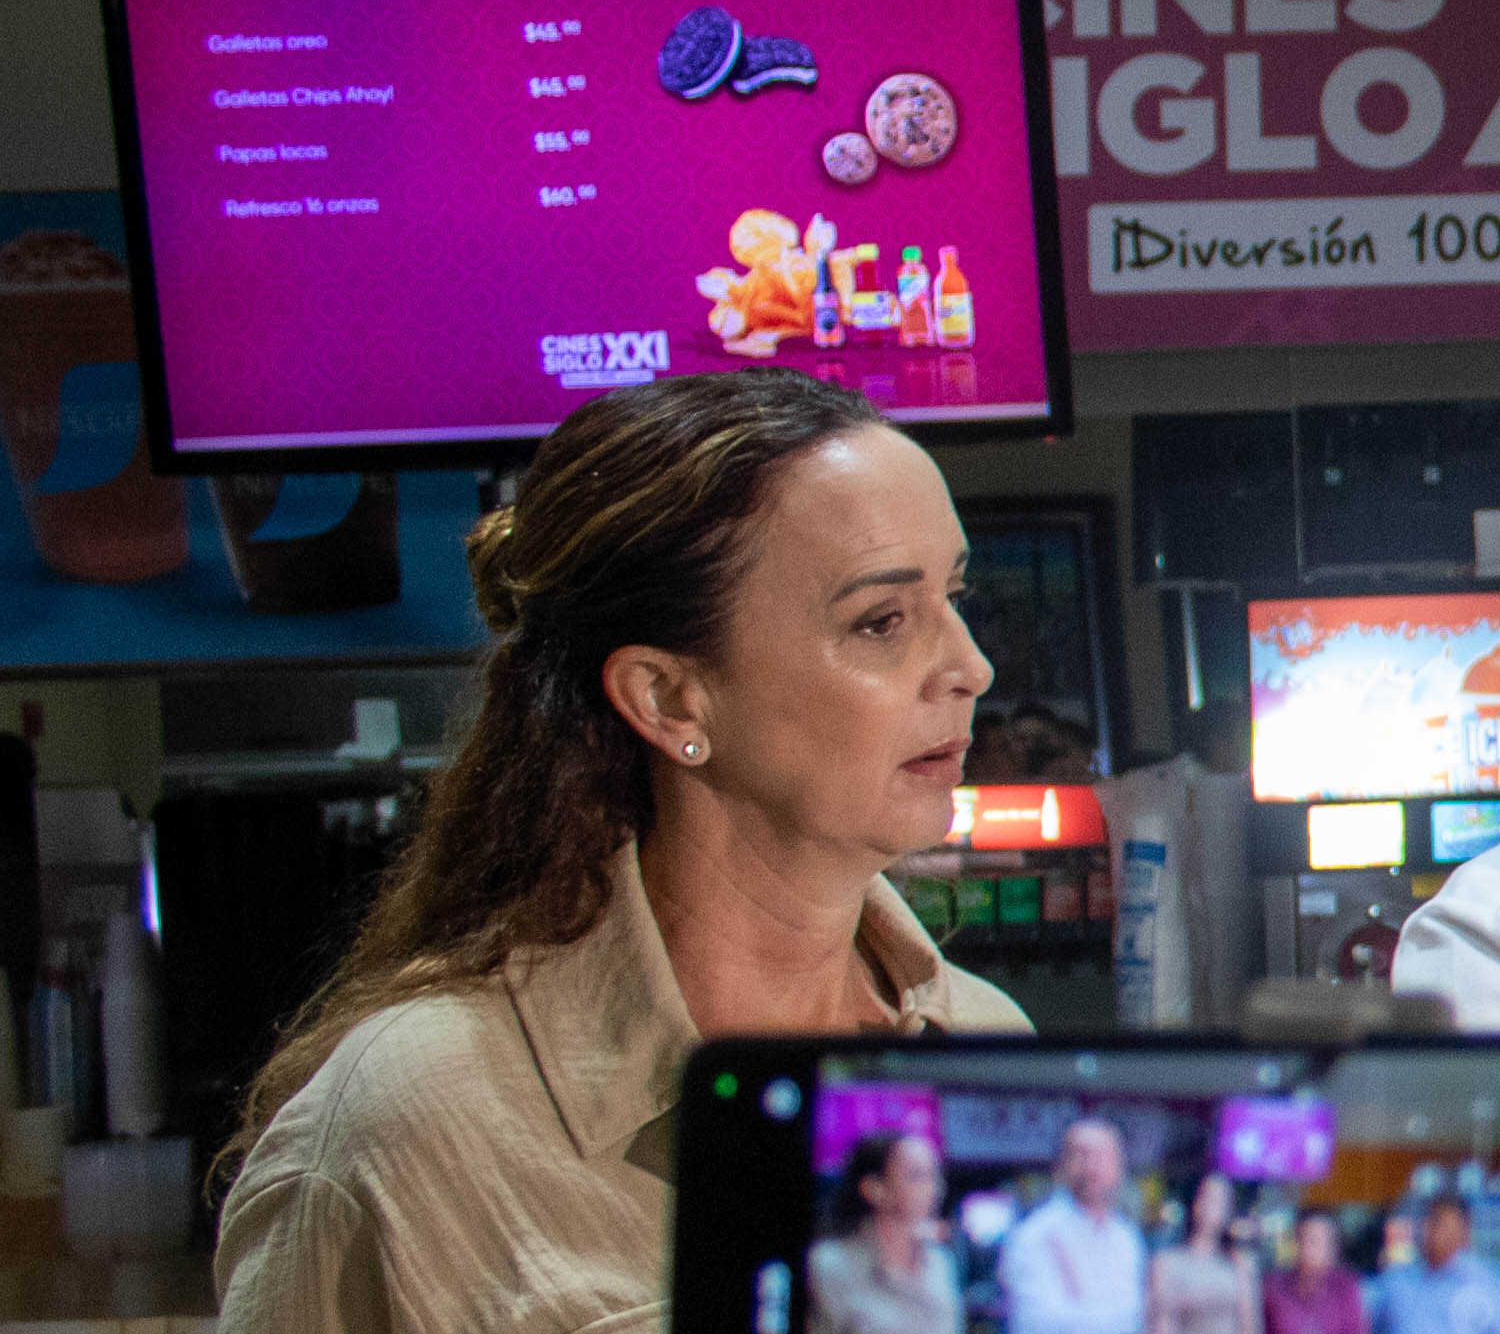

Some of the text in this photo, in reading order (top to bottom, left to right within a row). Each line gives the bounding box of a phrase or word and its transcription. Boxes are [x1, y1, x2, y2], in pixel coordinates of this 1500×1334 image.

[208, 35, 283, 53] Galletas
[214, 89, 289, 108] Galletas
[292, 86, 342, 107] Chips
[1052, 46, 1447, 178] IGLO
[219, 144, 278, 166] Papas
[602, 330, 671, 371] XXI
